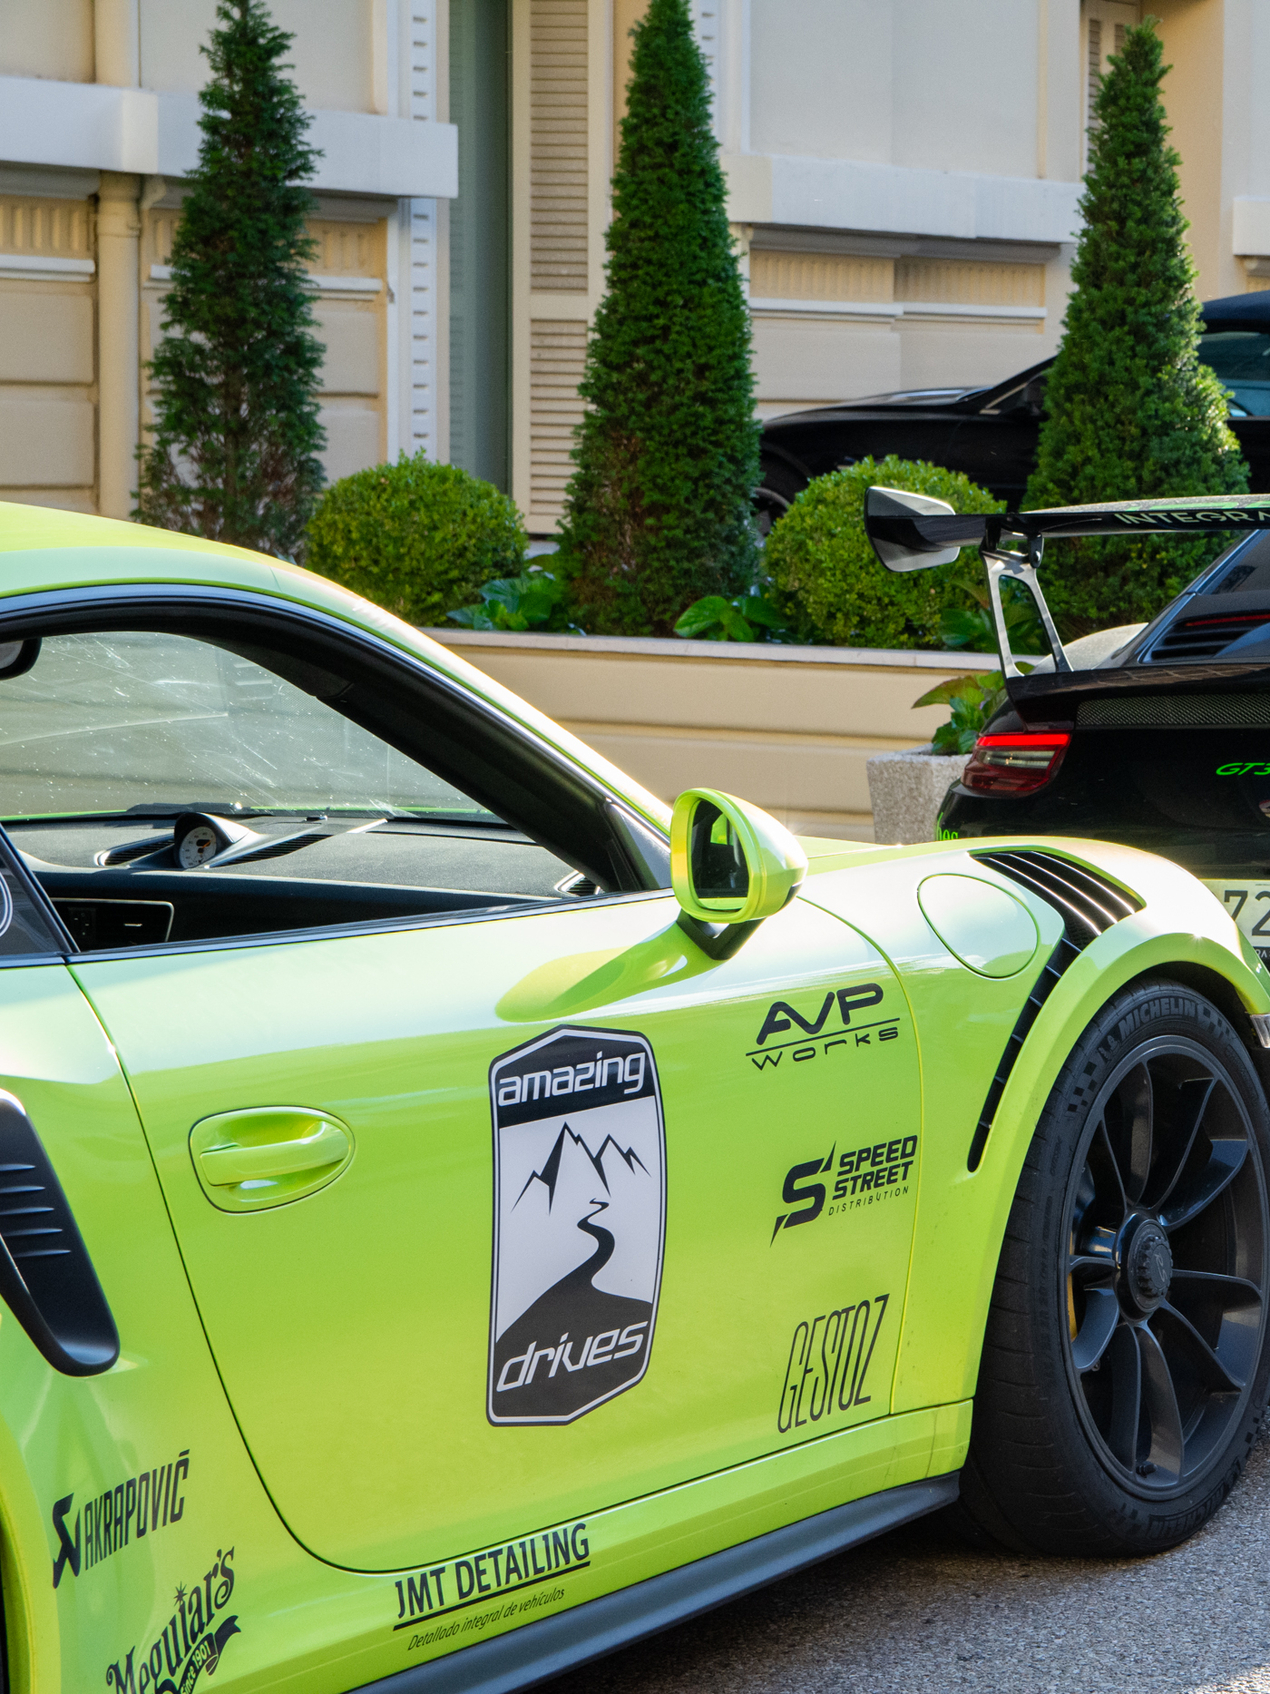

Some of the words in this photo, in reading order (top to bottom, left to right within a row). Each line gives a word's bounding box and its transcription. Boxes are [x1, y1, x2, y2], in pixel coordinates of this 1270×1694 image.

[756, 983, 884, 1045] AVP
[1119, 998, 1201, 1041] MICHELIN
[498, 1050, 647, 1107] amazing
[832, 1160, 914, 1201] STREET
[837, 1135, 918, 1178] SPEED
[828, 1186, 909, 1216] DISTRIBUTION
[496, 1320, 649, 1393] drives
[778, 1293, 890, 1434] GESTOZ
[395, 1566, 446, 1619] JMT
[455, 1522, 590, 1600] DETAILING
[408, 1621, 460, 1650] Detallado
[461, 1605, 503, 1633] integral
[503, 1604, 517, 1618] de
[519, 1587, 565, 1613] vehículos
[192, 1641, 211, 1670] 1901
